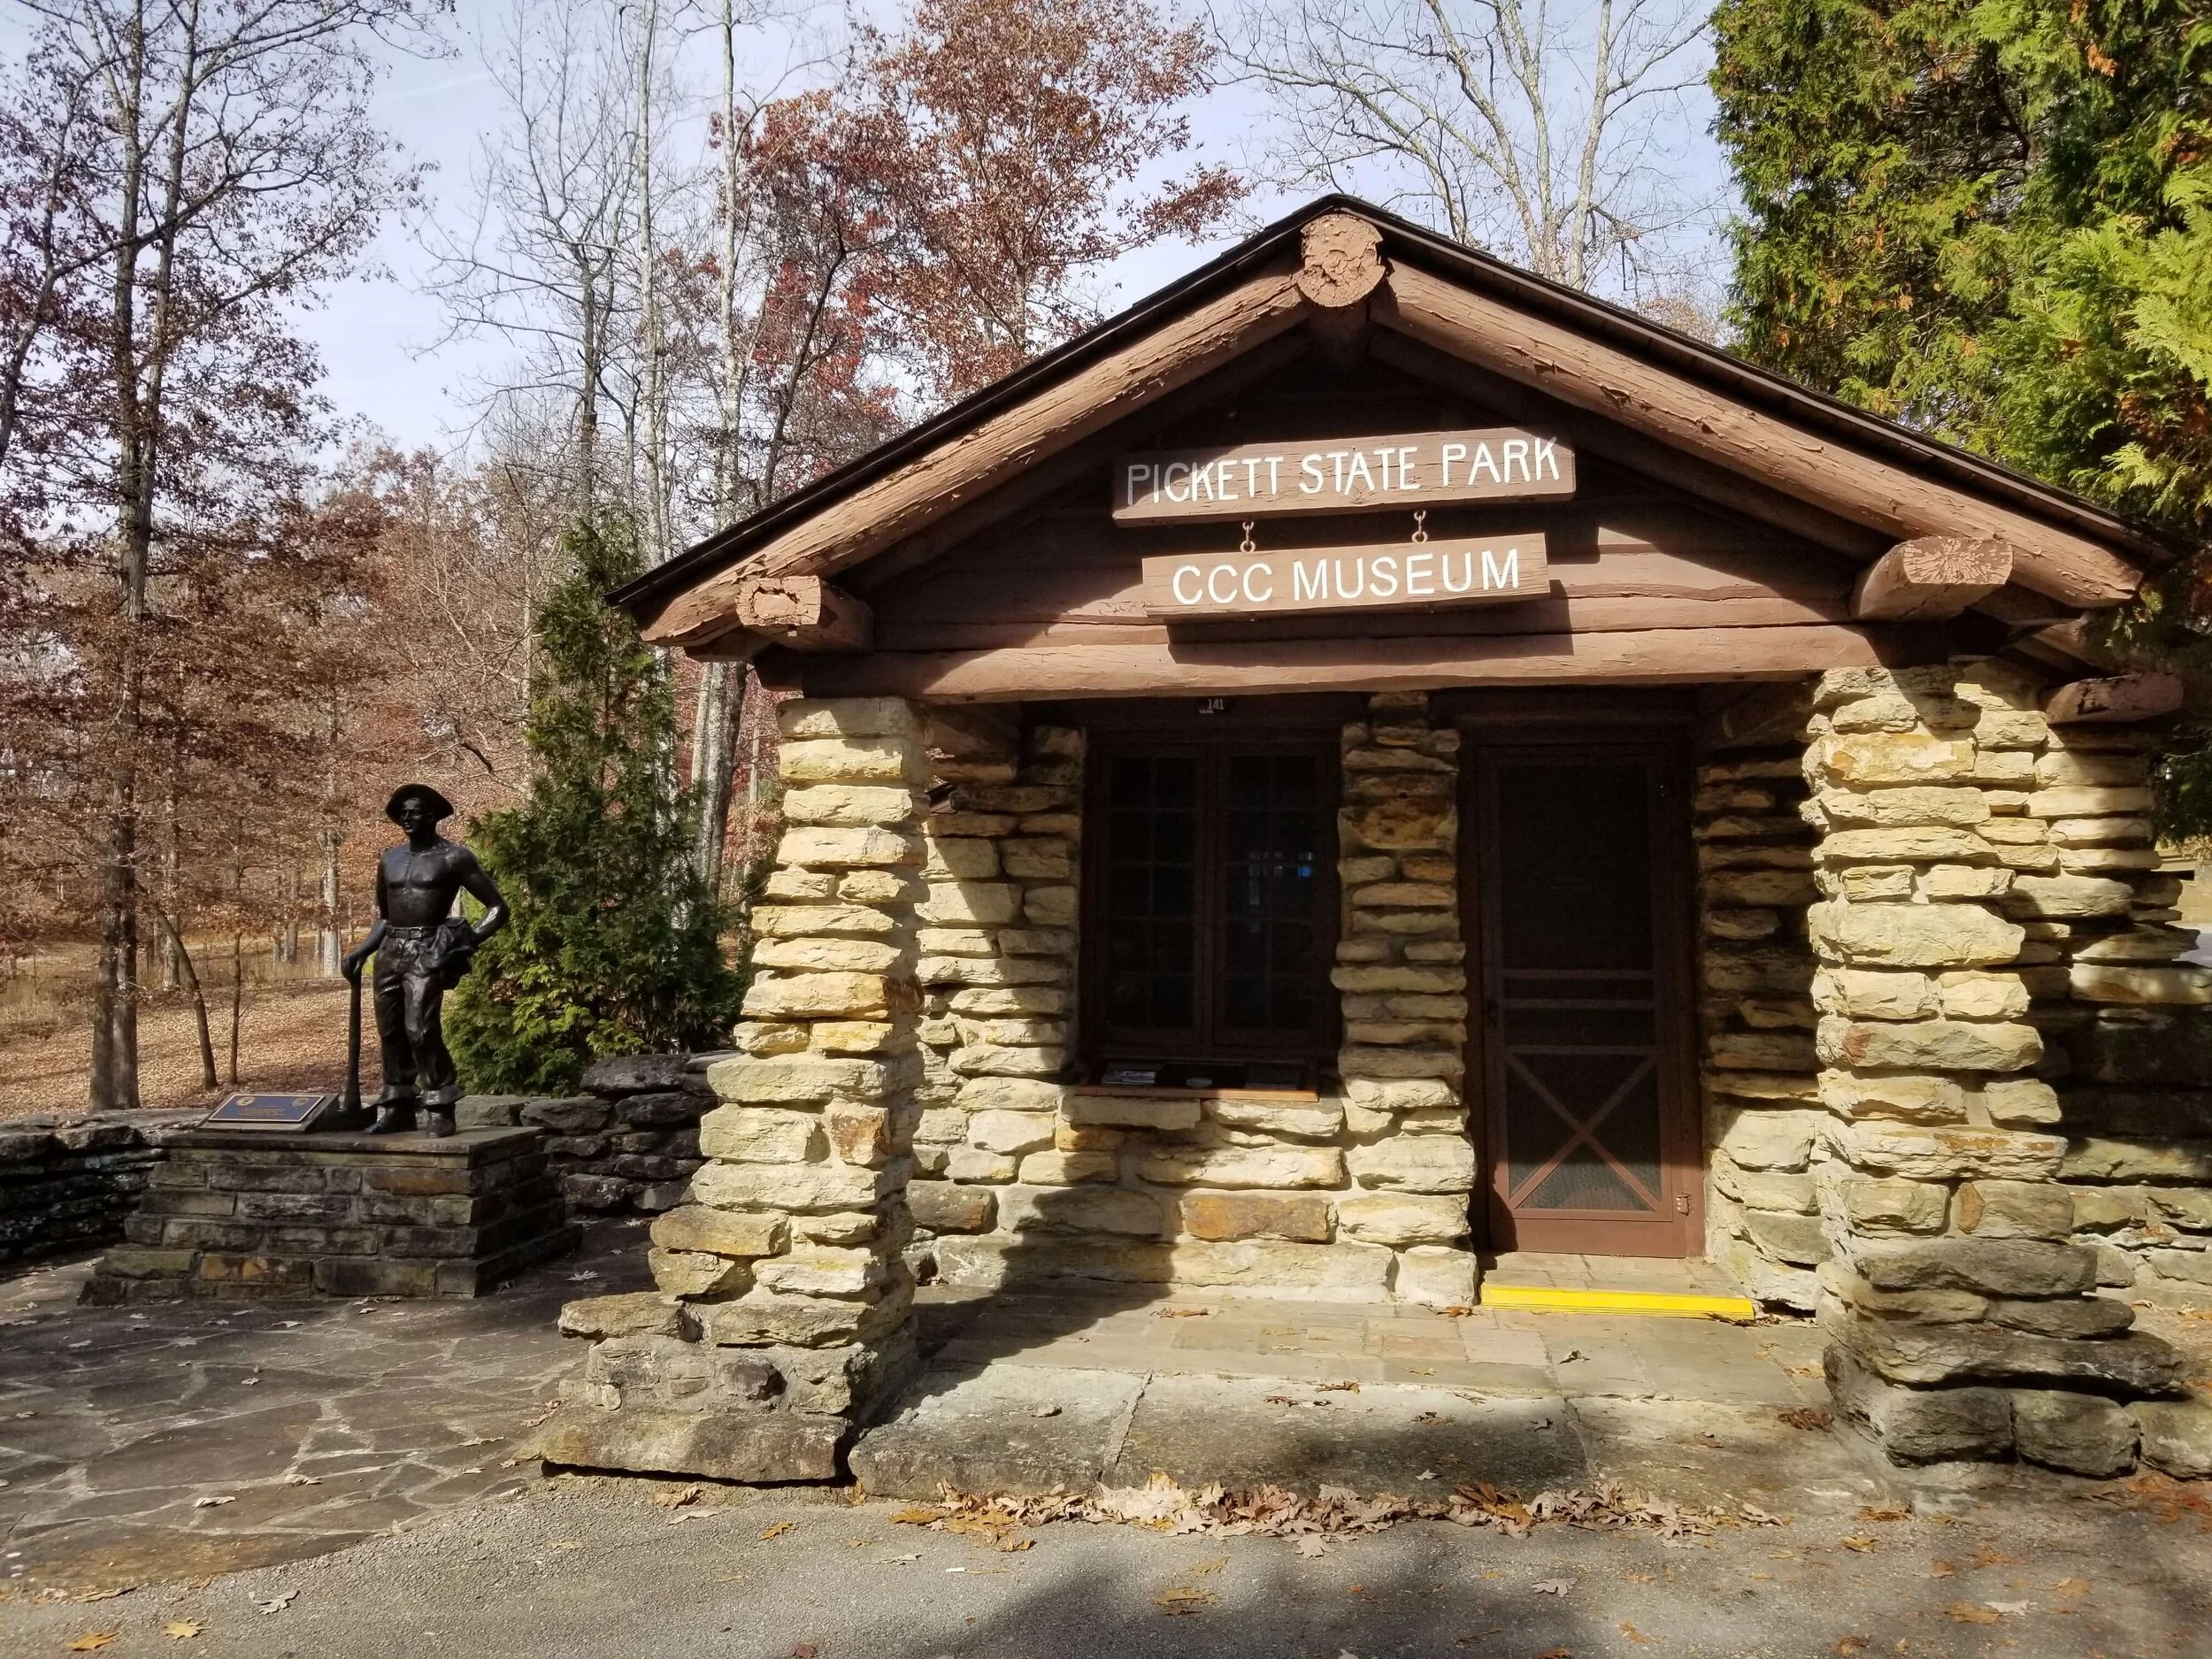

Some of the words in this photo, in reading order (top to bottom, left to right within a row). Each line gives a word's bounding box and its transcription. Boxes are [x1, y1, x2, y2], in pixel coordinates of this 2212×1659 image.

[1127, 456, 1285, 506] PICKETT
[1299, 446, 1421, 495] STATE
[1441, 437, 1559, 486] PARK
[1171, 563, 1273, 604] CCC
[1293, 549, 1518, 601] MUSEUM
